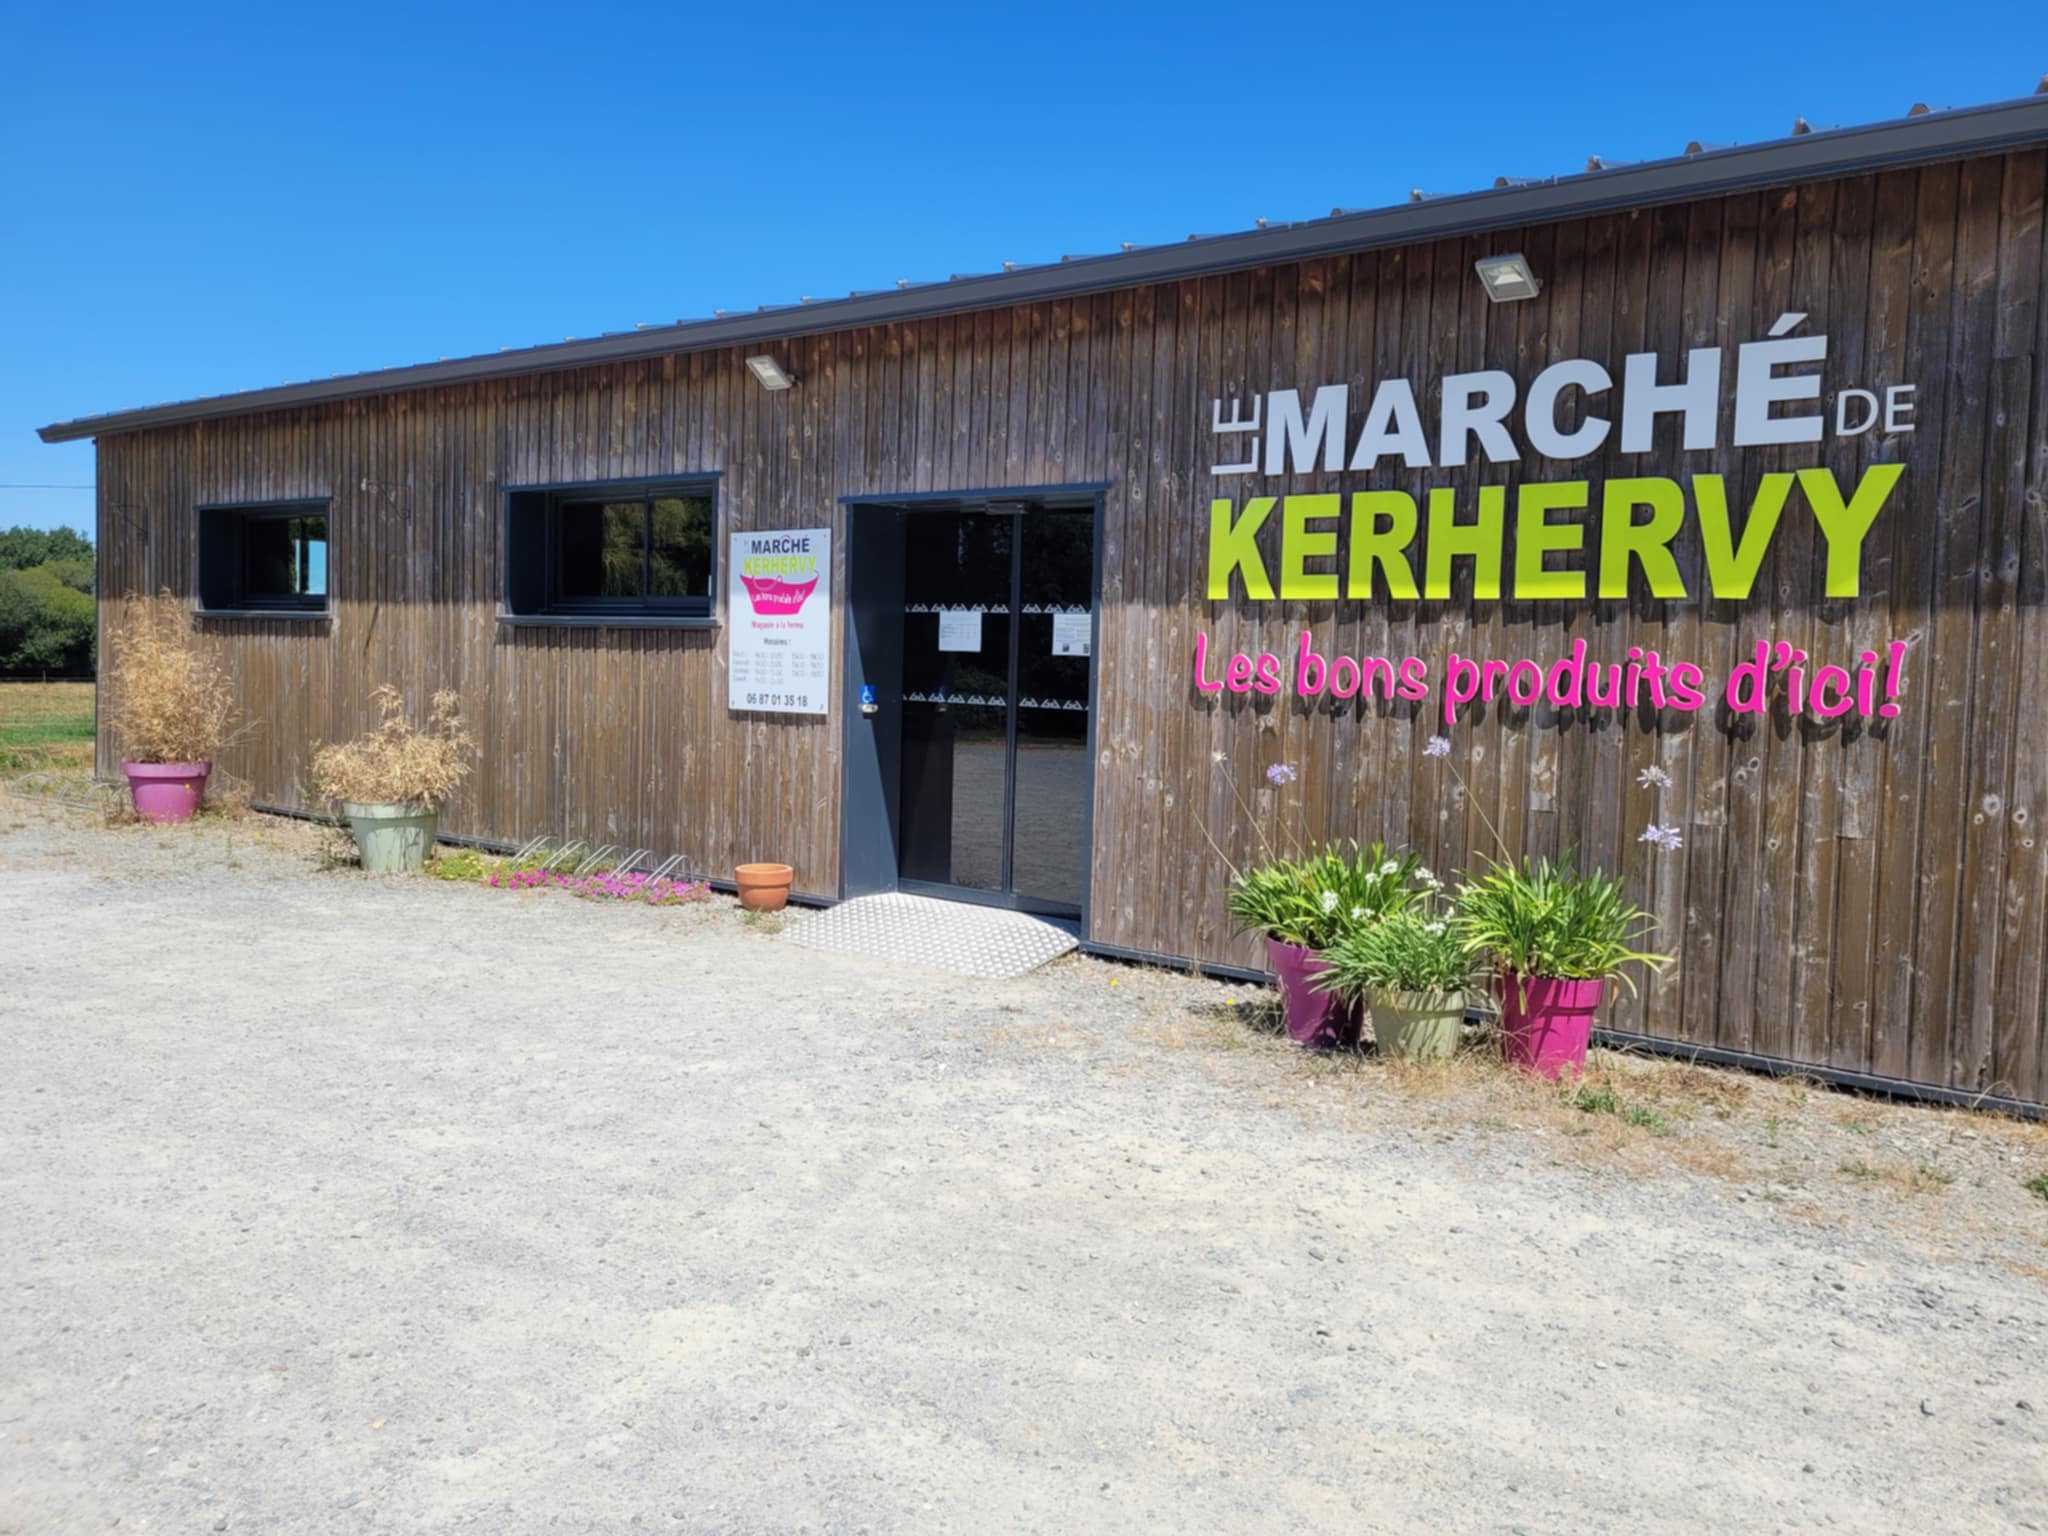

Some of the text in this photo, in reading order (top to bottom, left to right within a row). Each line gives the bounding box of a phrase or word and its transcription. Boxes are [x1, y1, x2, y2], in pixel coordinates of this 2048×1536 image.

[1211, 312, 1917, 476] LE MARCHÉ DE
[743, 555, 816, 575] KERHERVY
[1207, 463, 1906, 601] KERHERVY
[759, 693, 769, 705] 87
[771, 694, 781, 706] 01
[784, 695, 795, 706] 35
[797, 696, 808, 707] 18
[1194, 632, 1281, 695] Les
[1297, 630, 1429, 702] bons
[1444, 637, 1704, 726] produits
